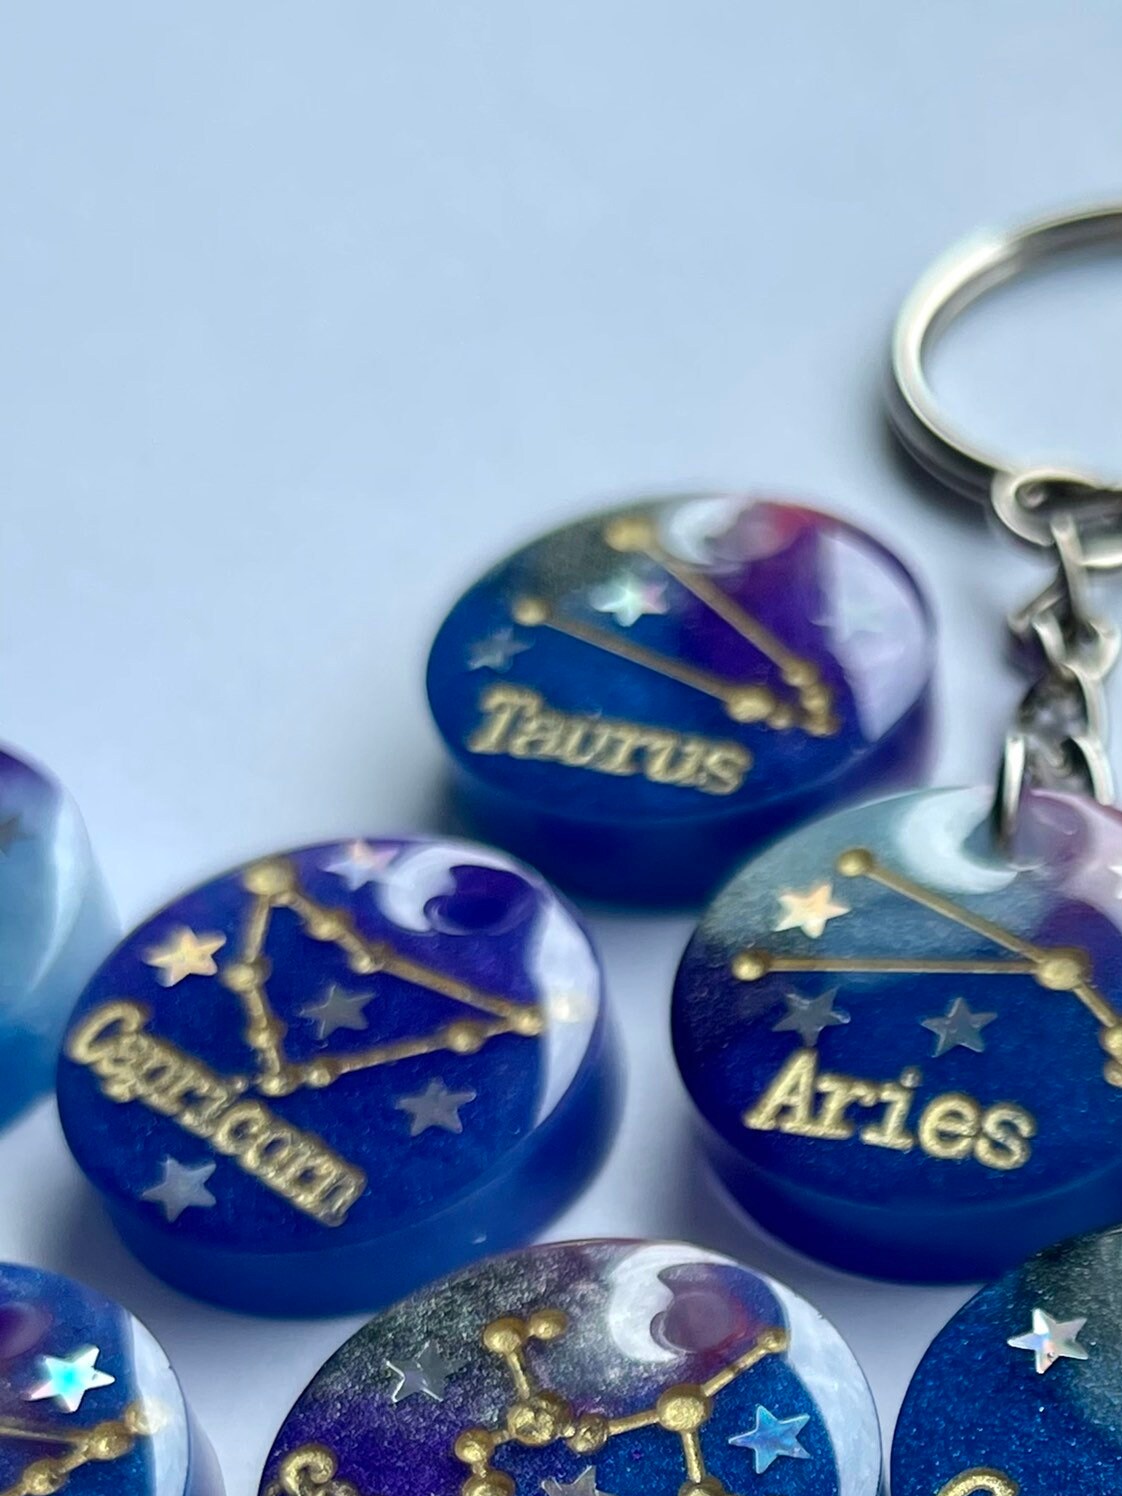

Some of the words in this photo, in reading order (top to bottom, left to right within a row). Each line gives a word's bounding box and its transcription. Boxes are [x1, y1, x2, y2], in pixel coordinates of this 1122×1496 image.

[468, 680, 754, 796] Taurus
[69, 1000, 368, 1228] Capricorn
[744, 1049, 1037, 1171] Aries
